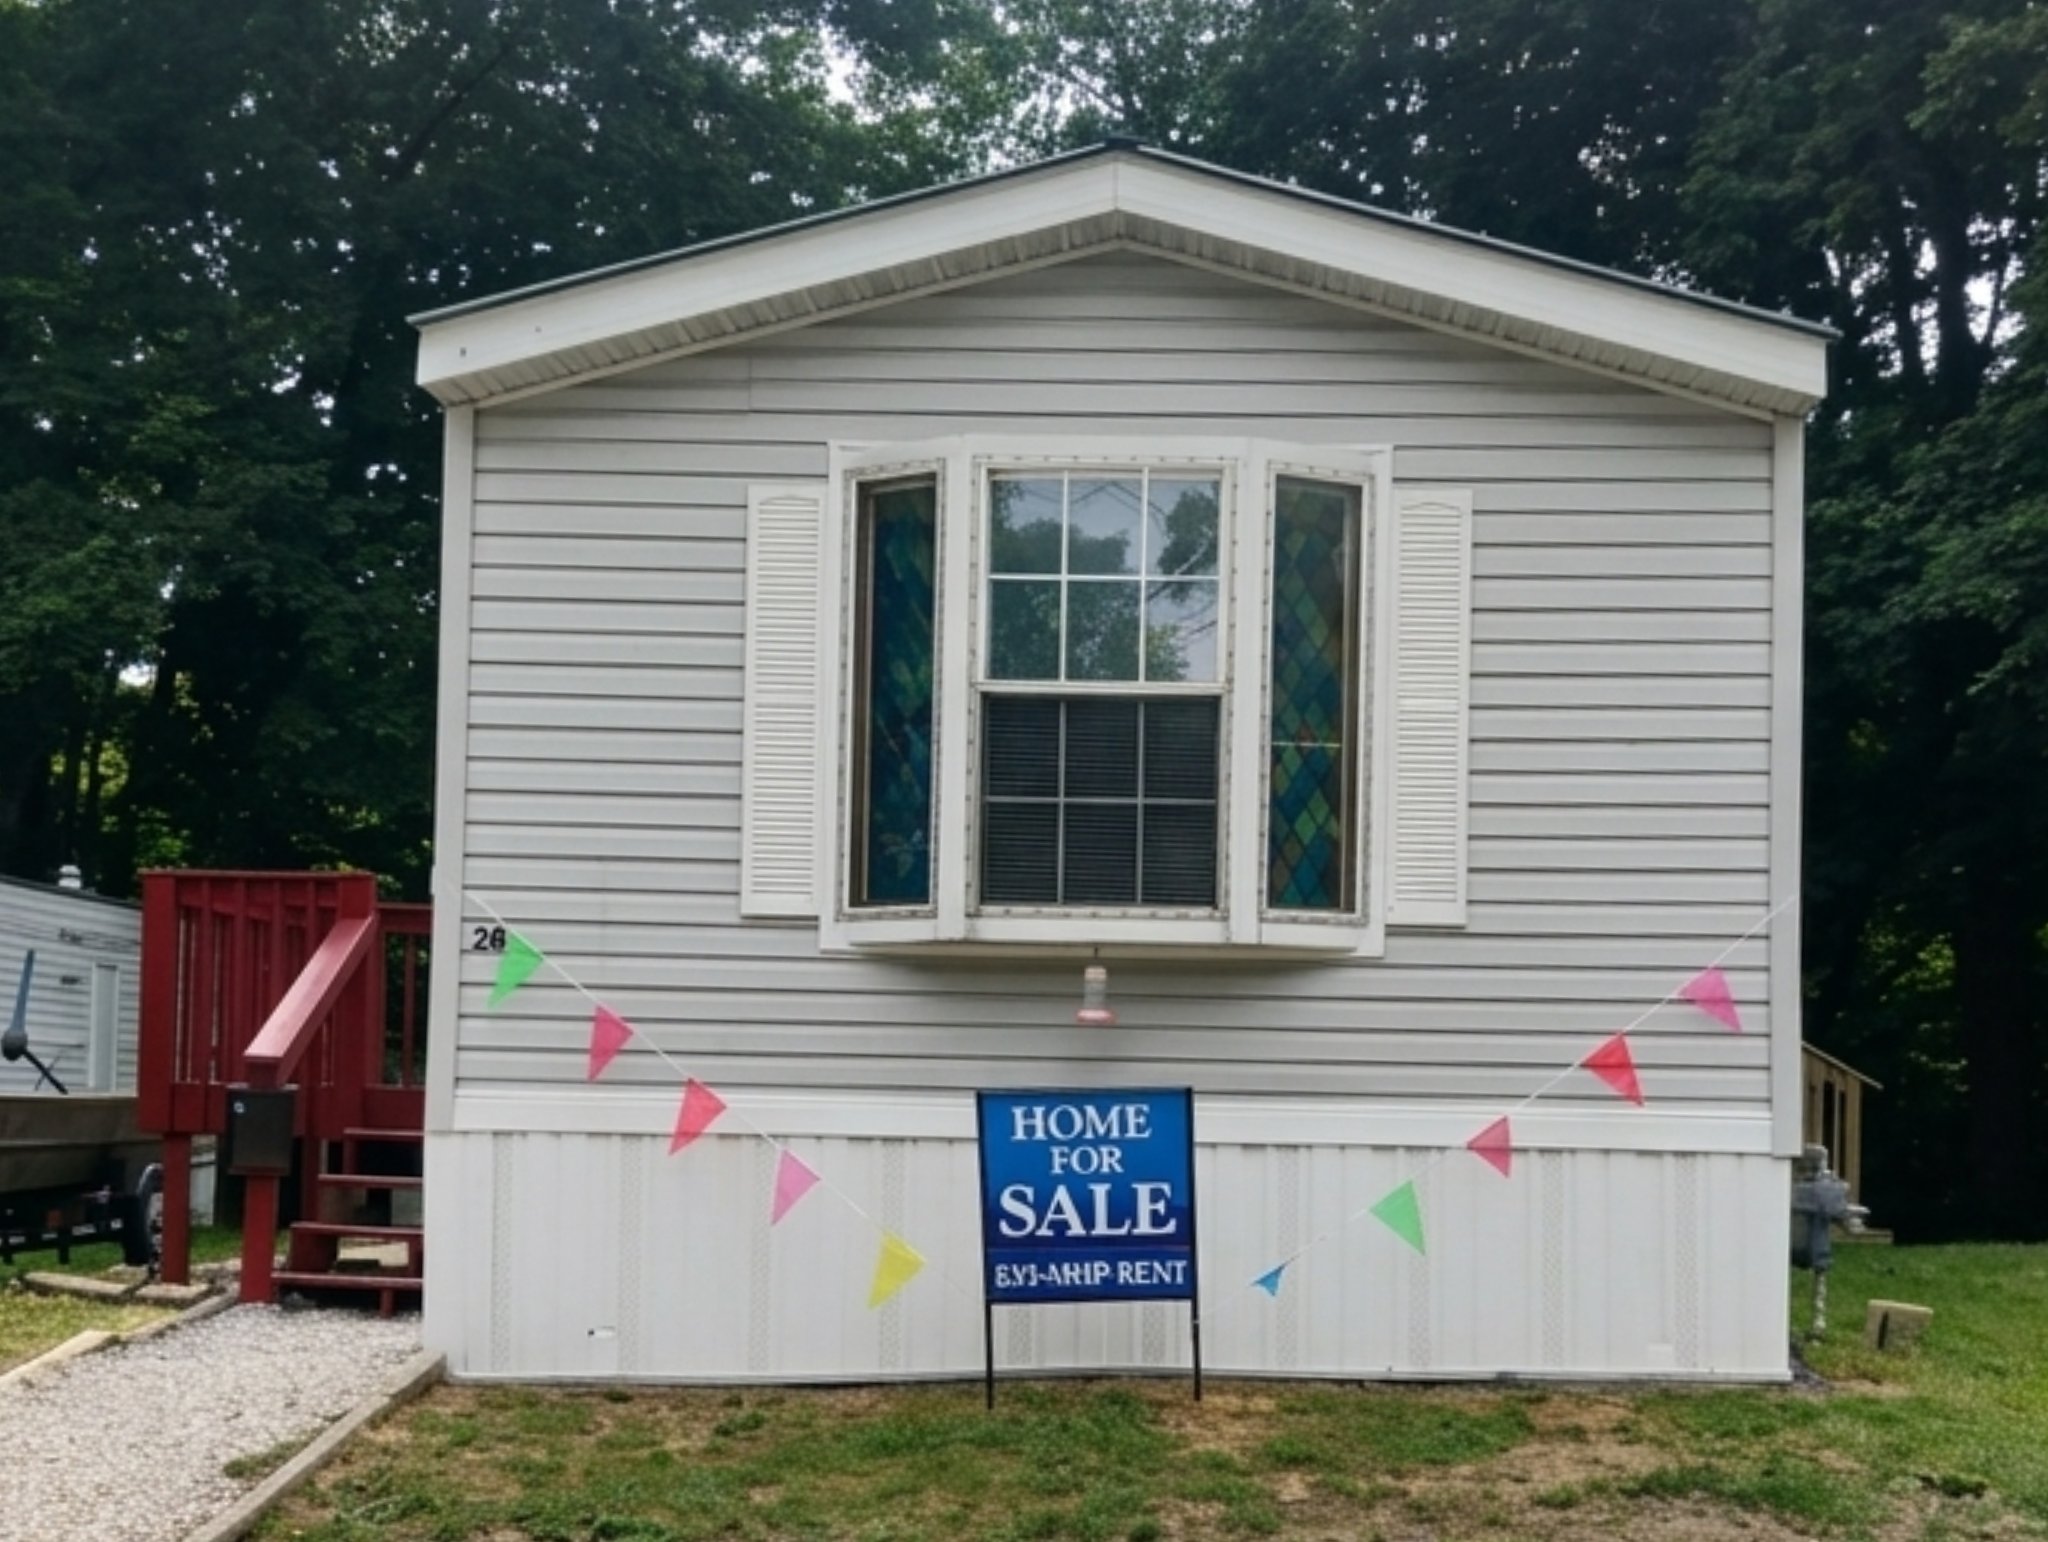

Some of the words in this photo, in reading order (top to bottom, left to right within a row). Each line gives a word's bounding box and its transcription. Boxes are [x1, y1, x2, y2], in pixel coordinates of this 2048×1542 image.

[1010, 1103, 1152, 1141] HOME
[1049, 1145, 1124, 1175] FOR
[999, 1181, 1177, 1238] SALE
[1117, 1259, 1188, 1286] RENT
